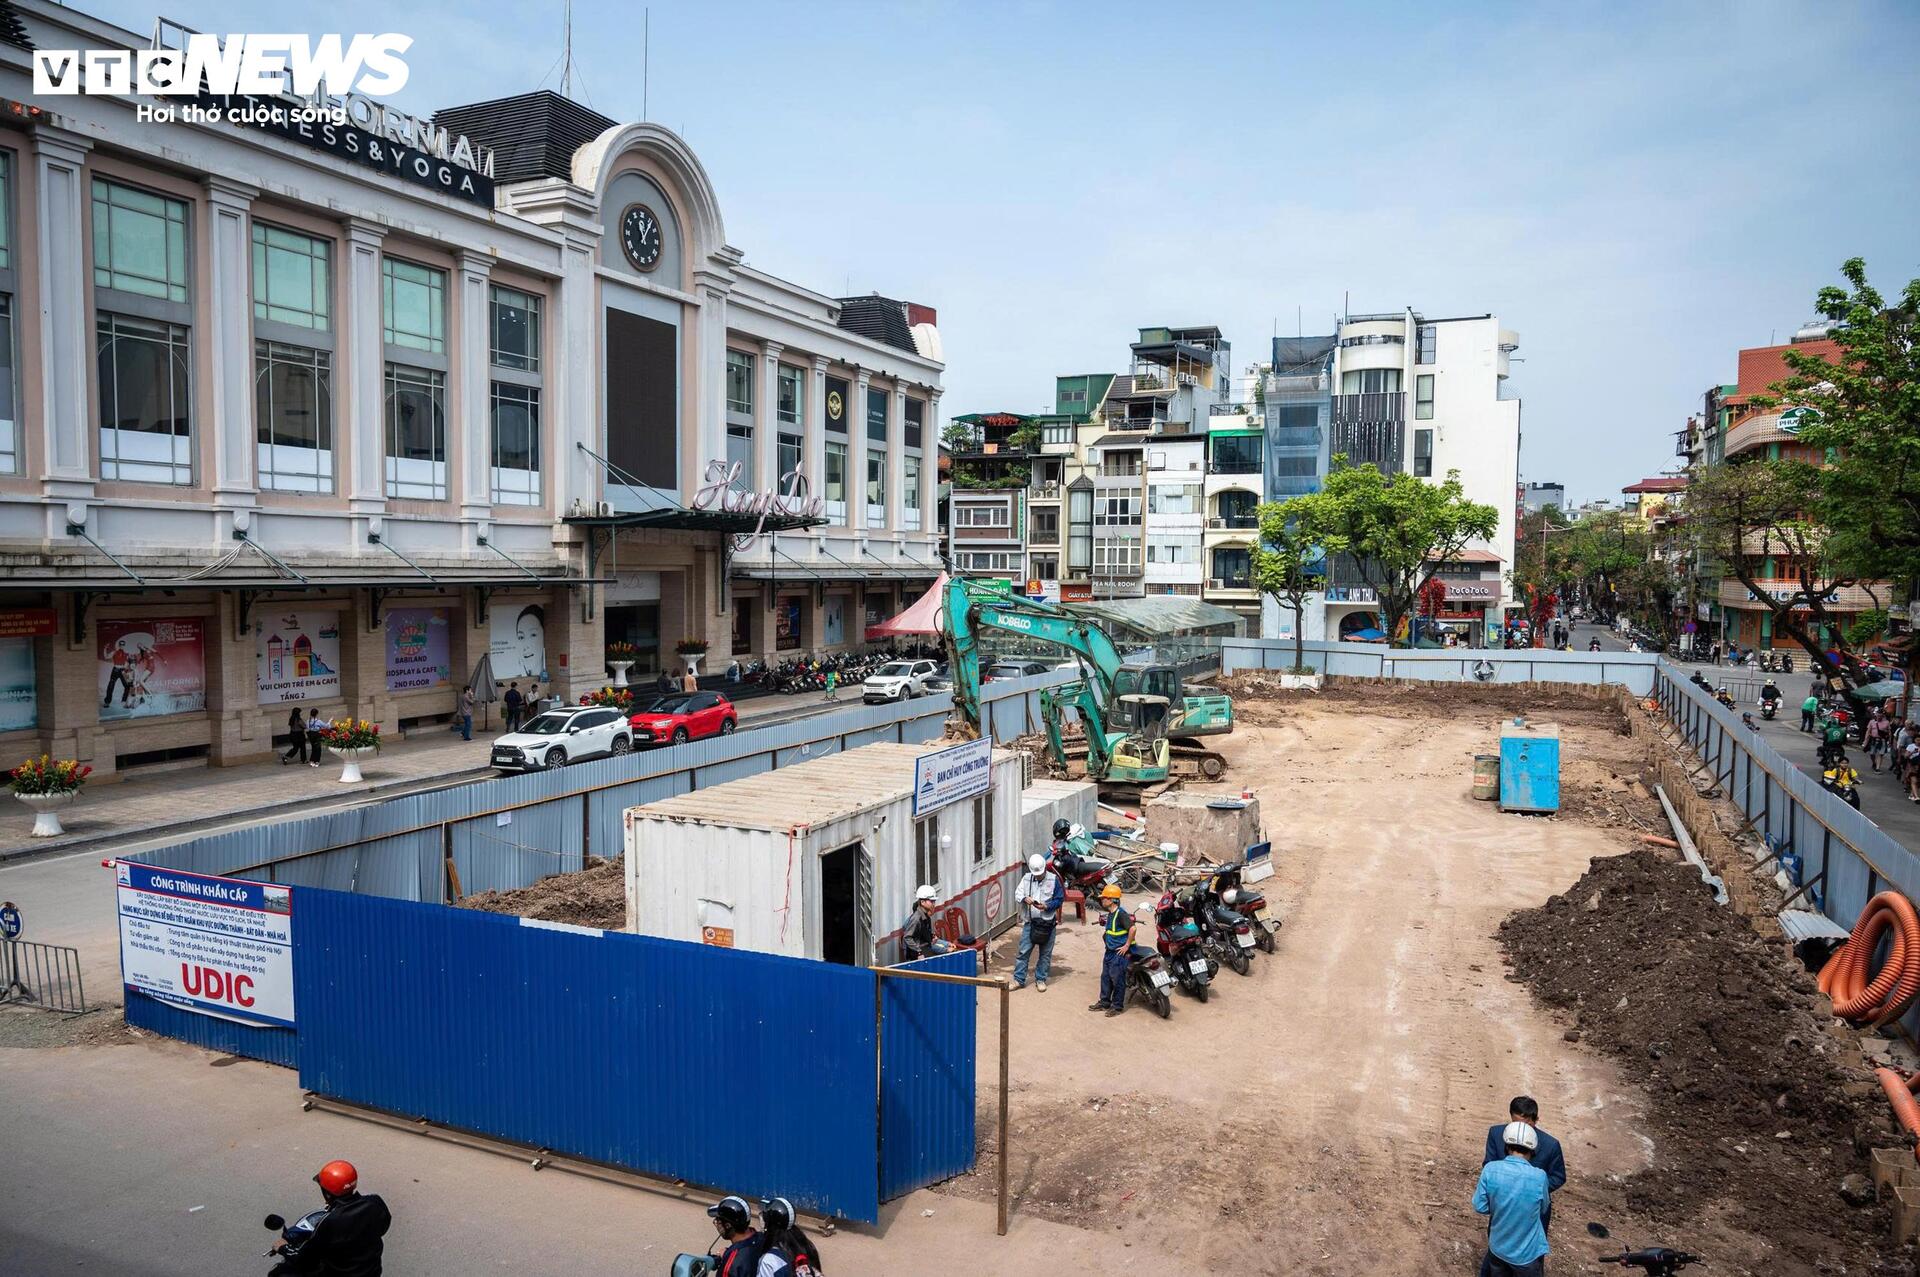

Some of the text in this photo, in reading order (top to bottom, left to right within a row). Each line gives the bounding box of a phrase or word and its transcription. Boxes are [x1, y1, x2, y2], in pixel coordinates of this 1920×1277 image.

[998, 614, 1031, 628] KOBELCO
[395, 656, 428, 664] BABILAND
[423, 666, 437, 674] CAFE
[322, 678, 337, 686] CAFE
[394, 678, 429, 688] 2ND FLOOR
[937, 772, 946, 783] BAN
[963, 761, 973, 774] CÔNG
[974, 756, 988, 770] TRƯỜNG
[151, 876, 248, 902] CÔNG TRÌNH KHẨN CẤP
[182, 962, 255, 1008] UDIC
